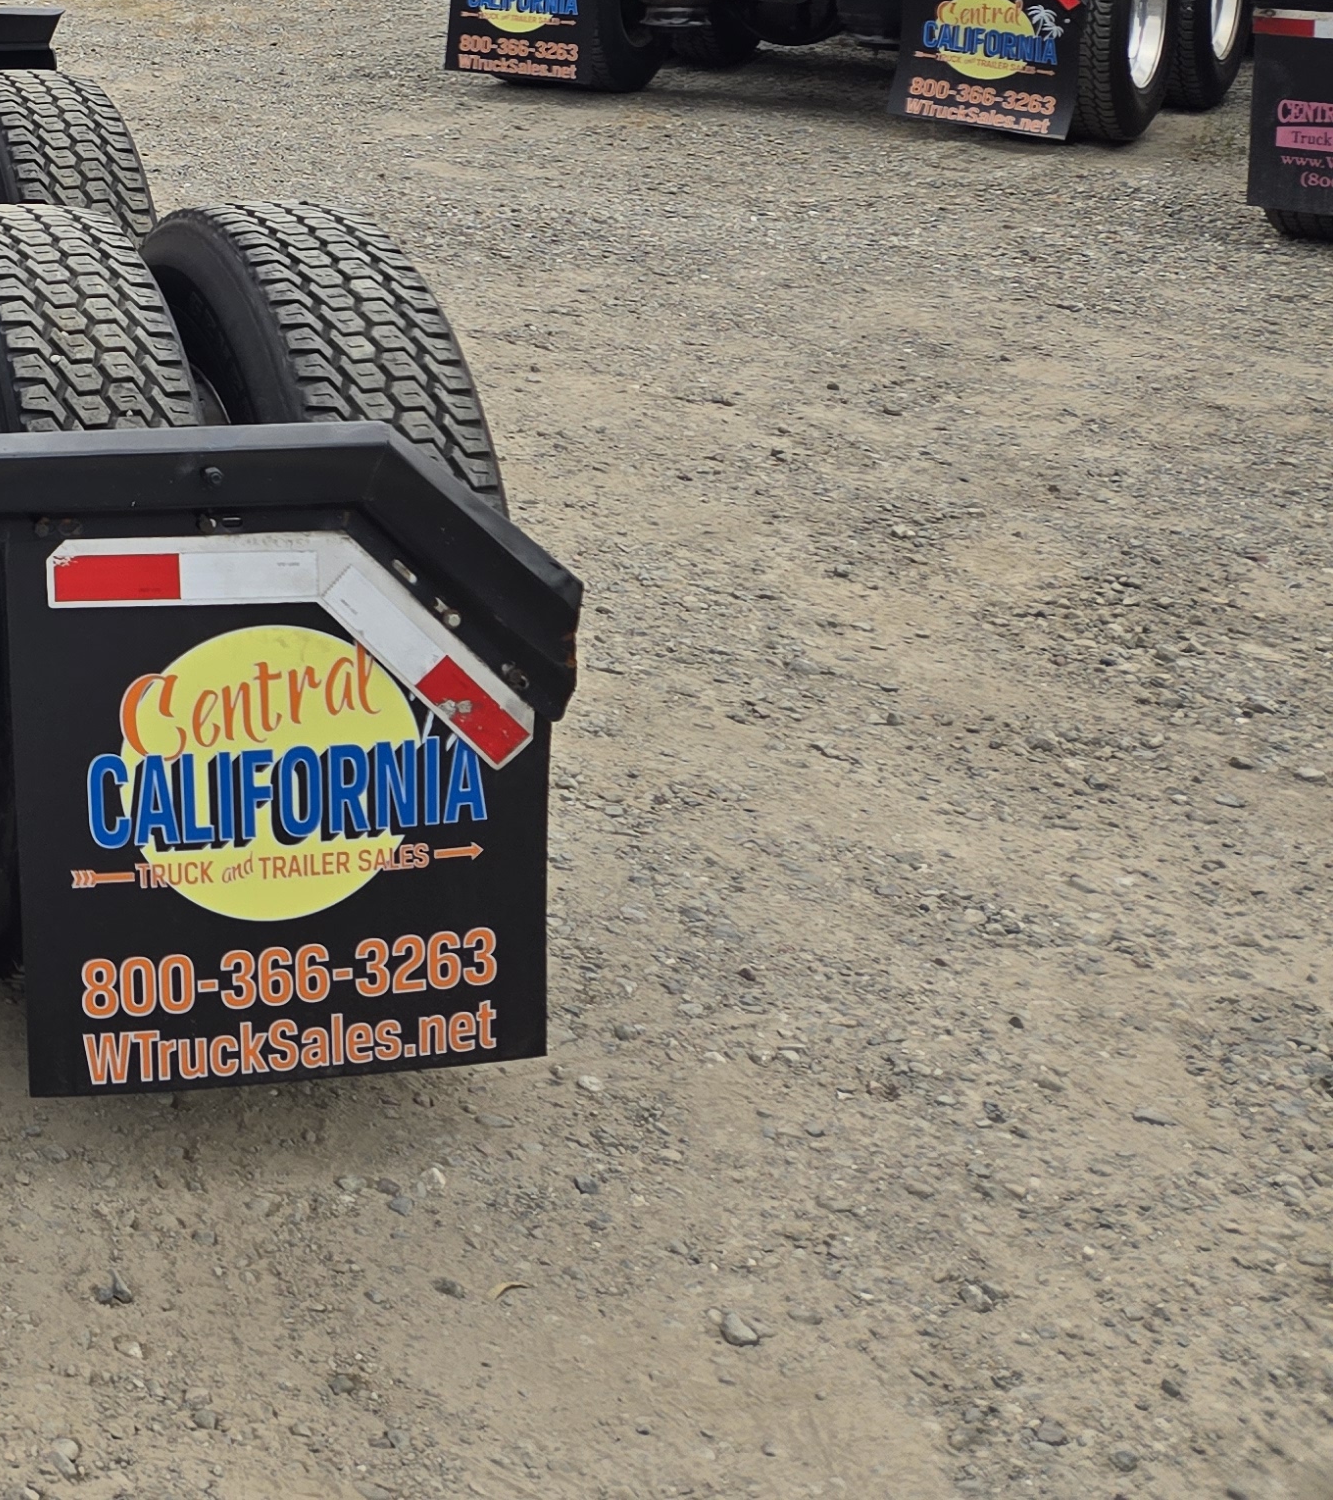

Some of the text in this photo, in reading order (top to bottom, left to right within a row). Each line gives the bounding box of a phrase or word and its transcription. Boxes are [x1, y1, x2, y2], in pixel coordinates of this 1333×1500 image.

[936, 0, 1024, 26] Central
[459, 34, 579, 61] 800-366-3263
[922, 20, 1058, 66] CALIFORNIA
[458, 54, 577, 79] WTruckSales.net
[905, 97, 1051, 134] WTruckSales.net
[909, 76, 1056, 115] 800-366-3263
[1292, 131, 1332, 146] Truck
[120, 642, 381, 761] Central
[87, 735, 487, 850] CALIFORNIA
[136, 843, 430, 888] TRUCK and TRAILER SALES
[81, 927, 498, 1019] 800-366-3263
[83, 1000, 498, 1085] WTruckSales.net
